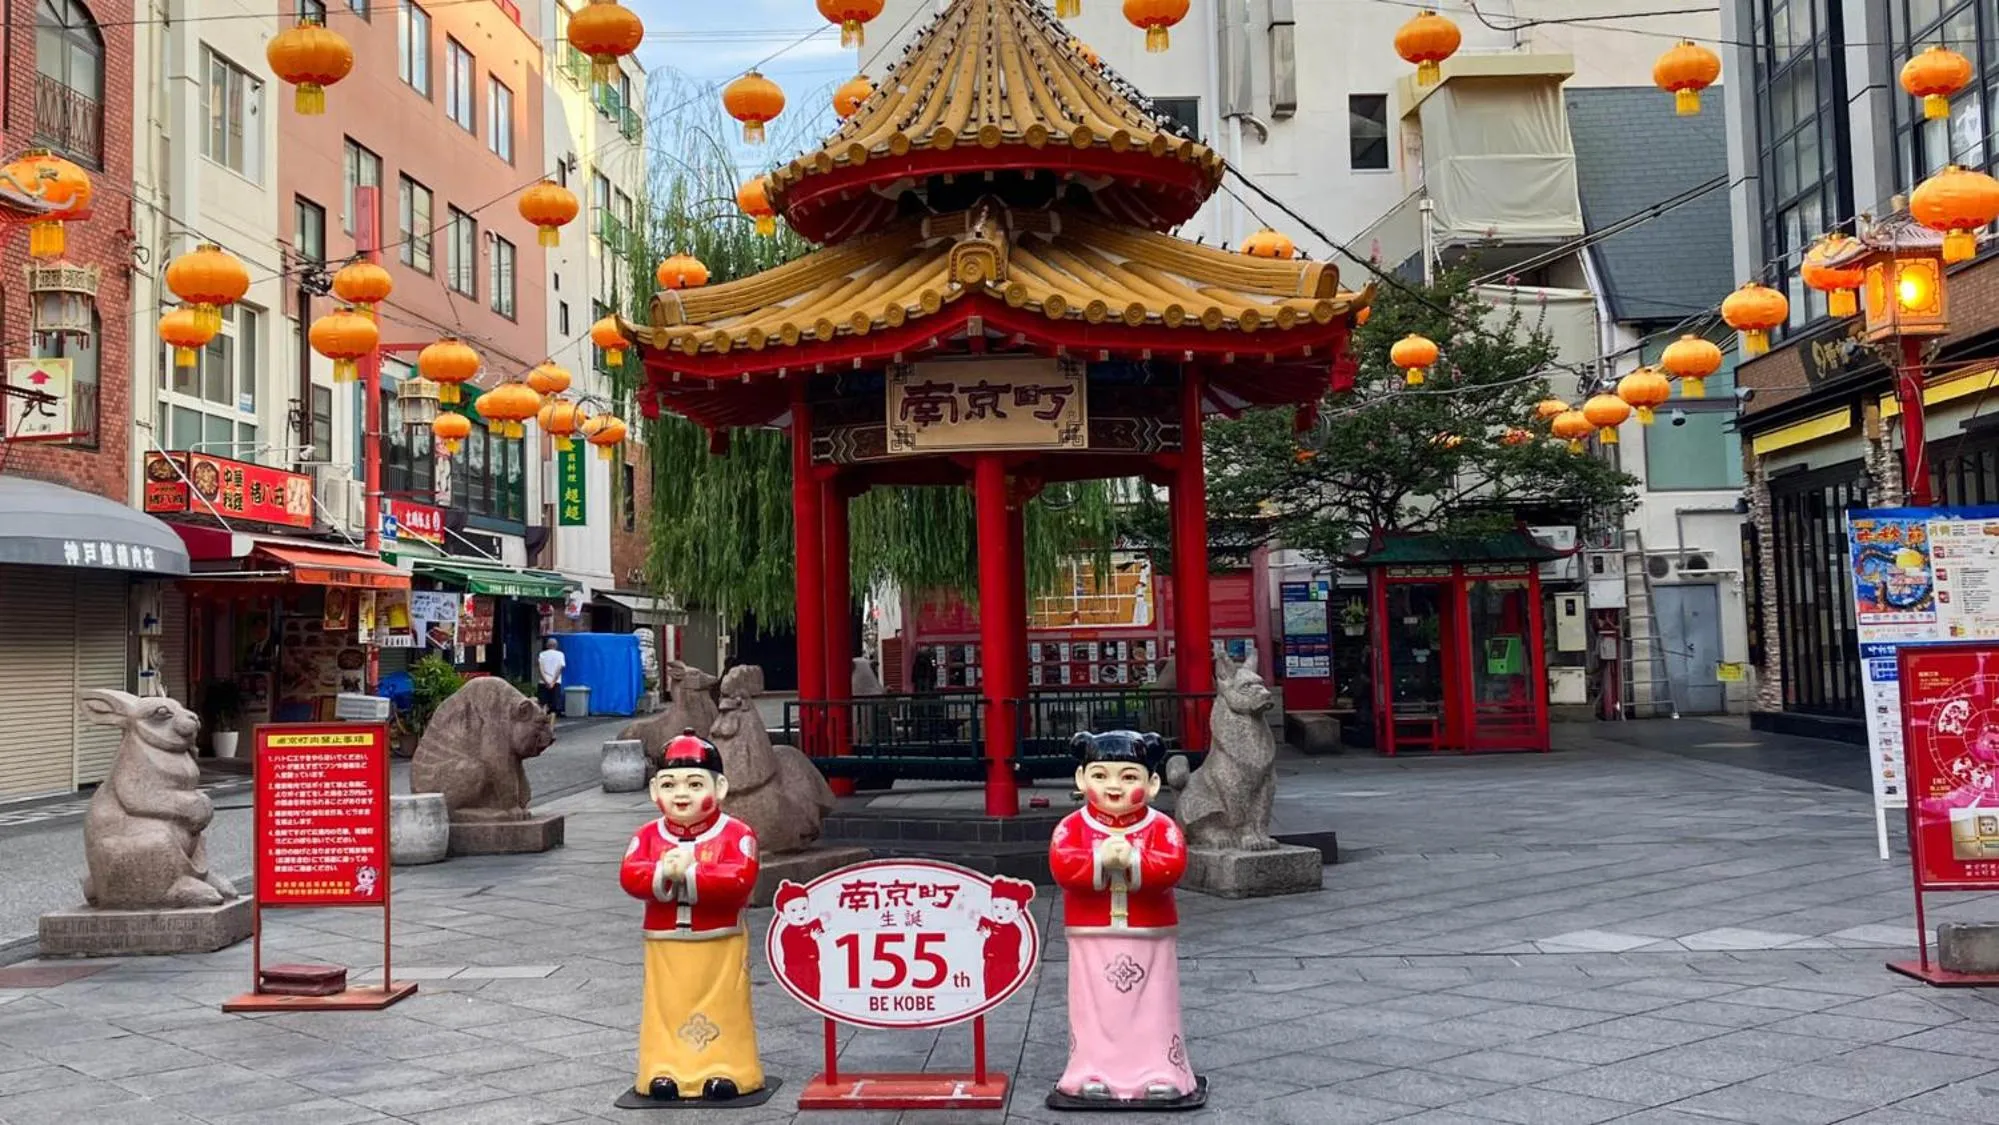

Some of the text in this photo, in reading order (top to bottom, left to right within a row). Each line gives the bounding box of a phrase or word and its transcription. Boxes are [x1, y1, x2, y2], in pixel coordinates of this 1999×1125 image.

[900, 379, 1074, 427] 南京町
[838, 879, 960, 912] 南京町
[879, 911, 924, 928] 生誕
[869, 996, 935, 1011] BE KOBE
